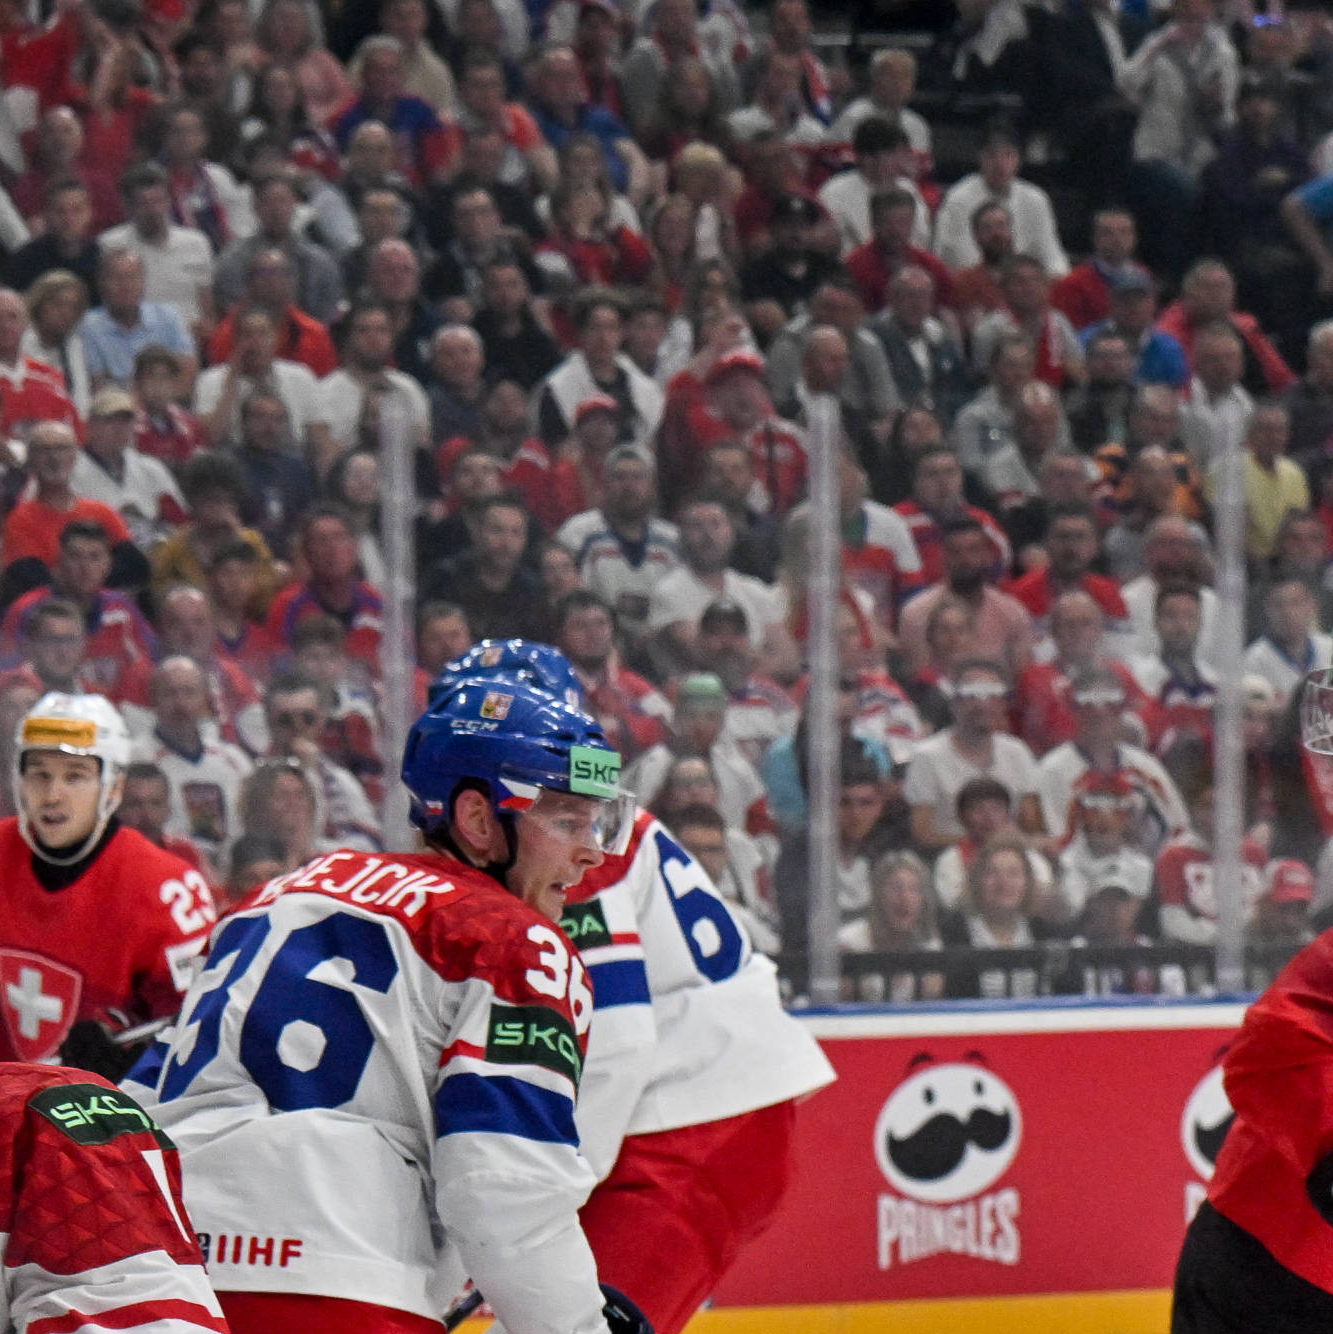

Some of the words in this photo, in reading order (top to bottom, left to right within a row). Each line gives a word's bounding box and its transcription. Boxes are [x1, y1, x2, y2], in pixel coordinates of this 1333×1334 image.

[160, 870, 216, 934] 23
[217, 1234, 303, 1268] IIHF
[877, 1186, 1020, 1271] PRINGLES
